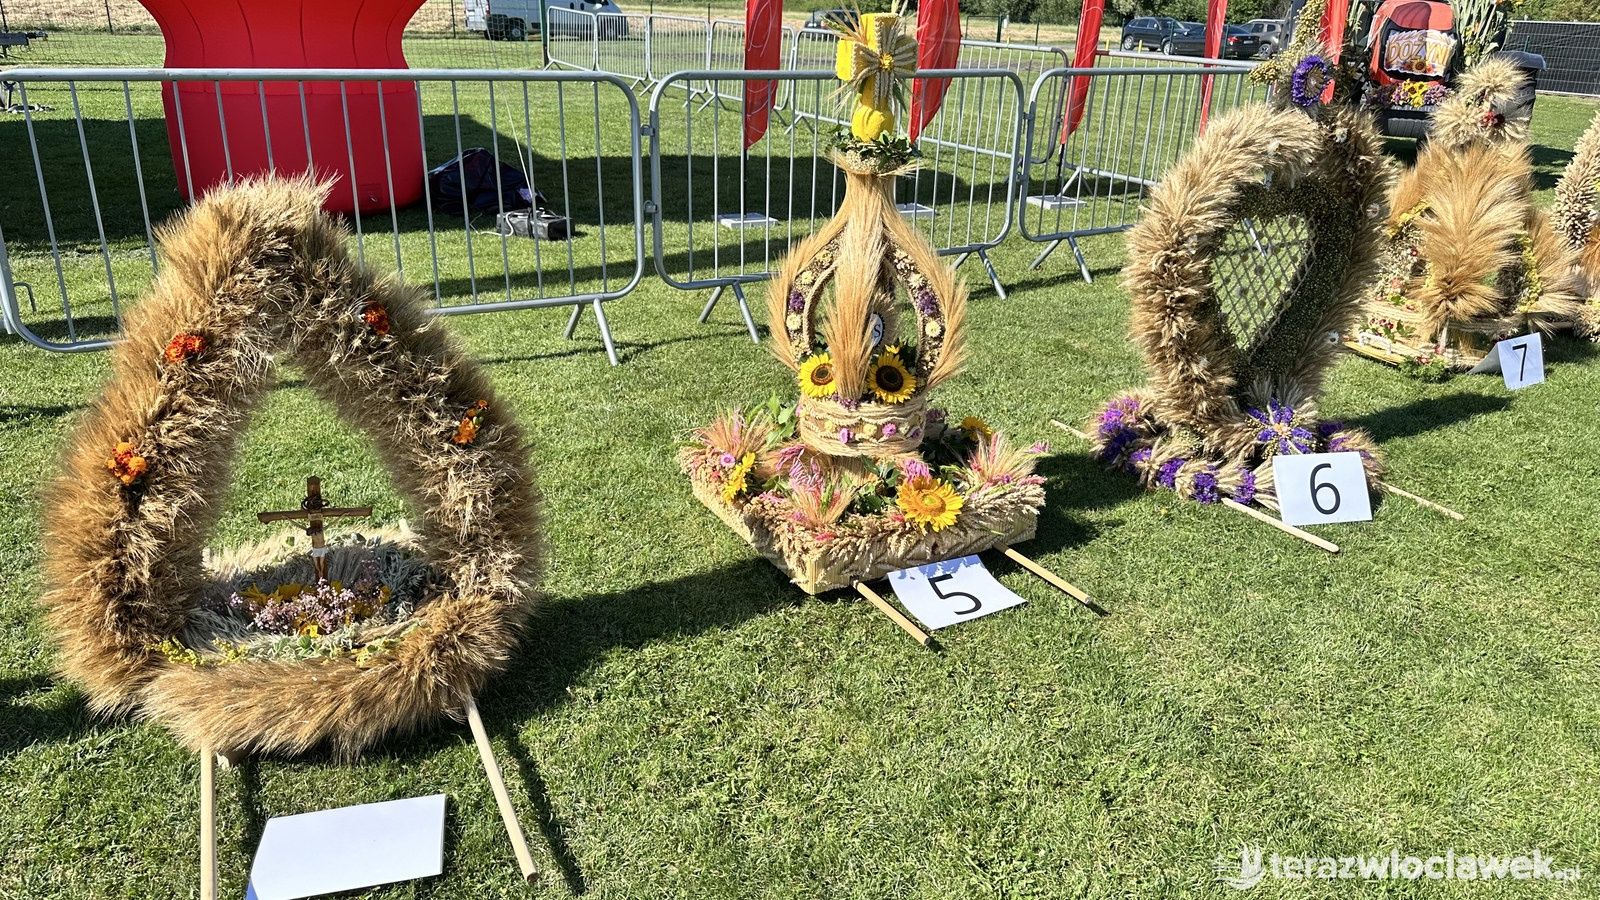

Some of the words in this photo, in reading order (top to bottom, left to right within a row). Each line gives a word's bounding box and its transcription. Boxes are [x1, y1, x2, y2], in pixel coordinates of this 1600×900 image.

[1512, 343, 1527, 381] 7
[1310, 463, 1340, 515] 6
[928, 573, 982, 616] 5
